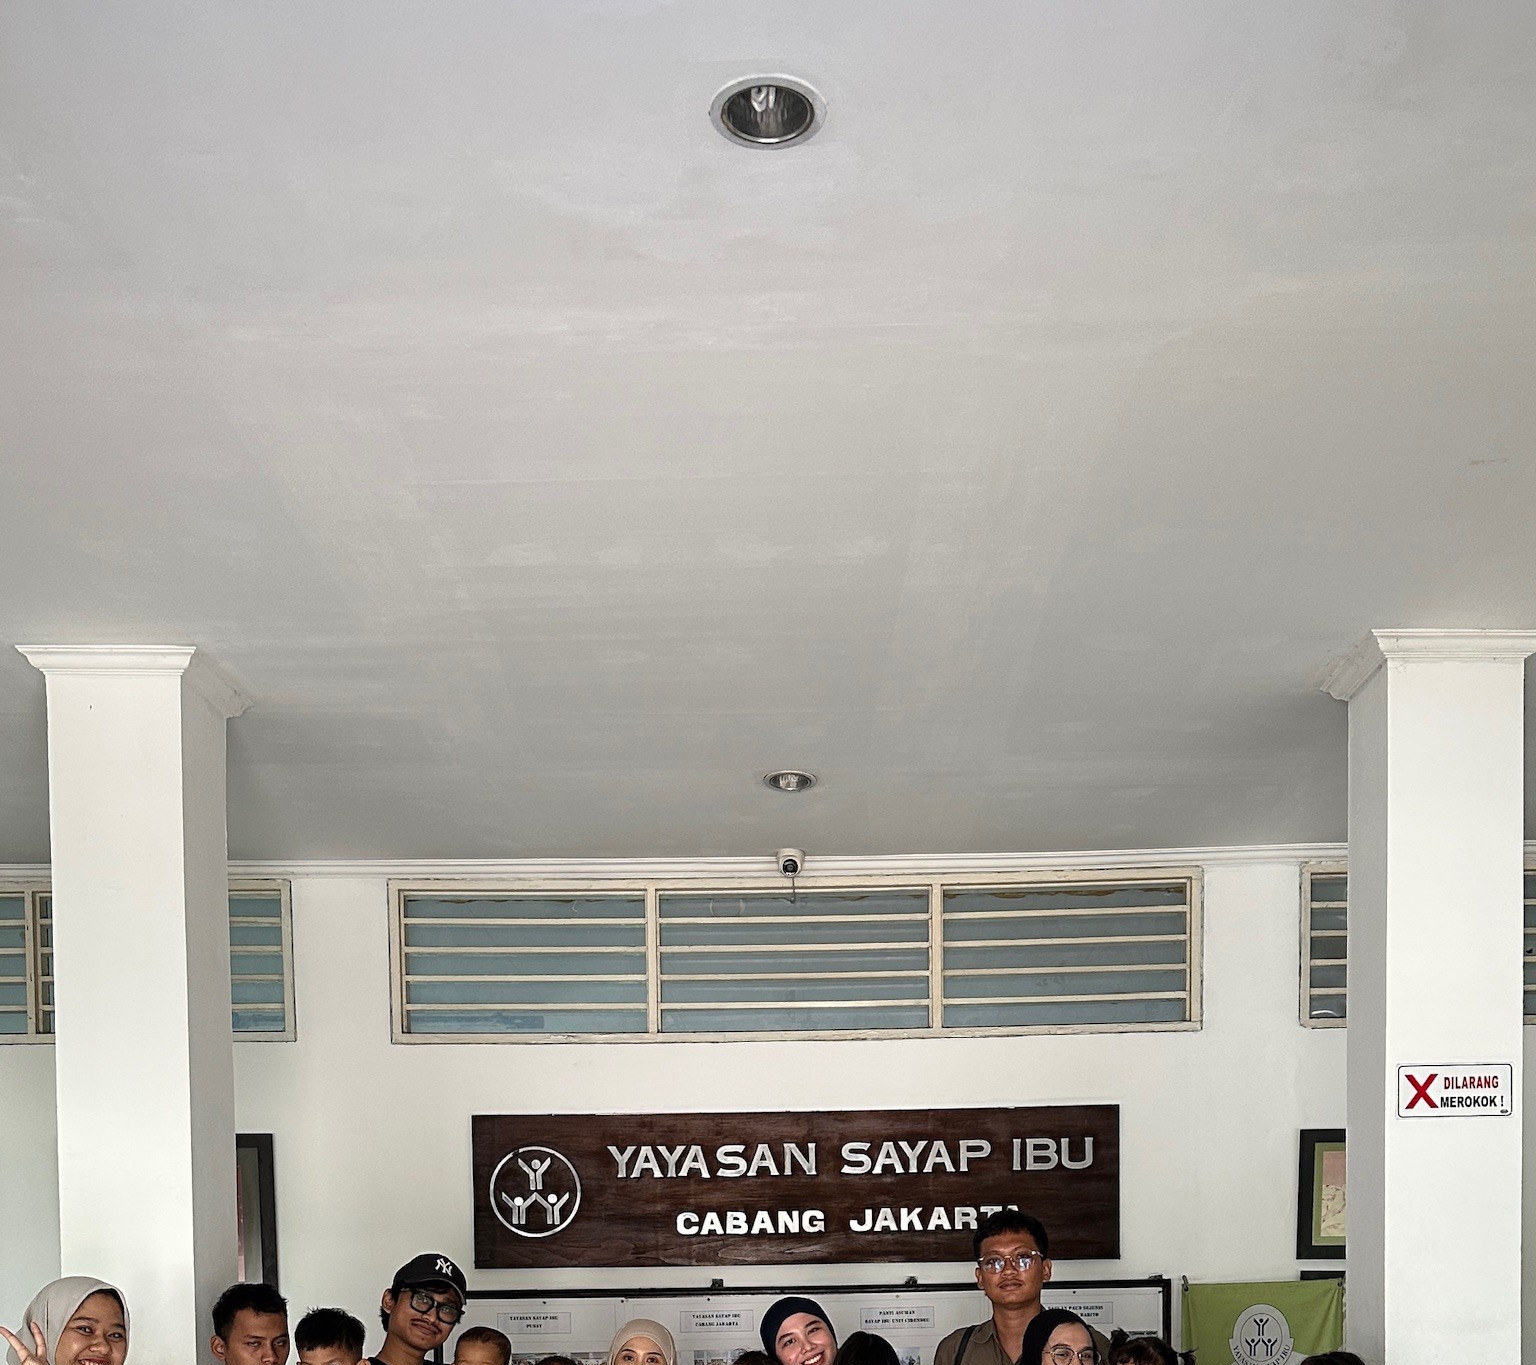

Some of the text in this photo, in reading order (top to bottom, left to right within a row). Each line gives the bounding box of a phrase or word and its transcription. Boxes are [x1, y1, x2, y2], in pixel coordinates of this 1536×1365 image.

[1443, 1075, 1499, 1090] DILARANG
[1440, 1095, 1497, 1108] MEROKOK
[607, 1136, 1094, 1178] YAYASAN SAYAP IBU
[676, 1204, 1020, 1236] CABANG JAKART
